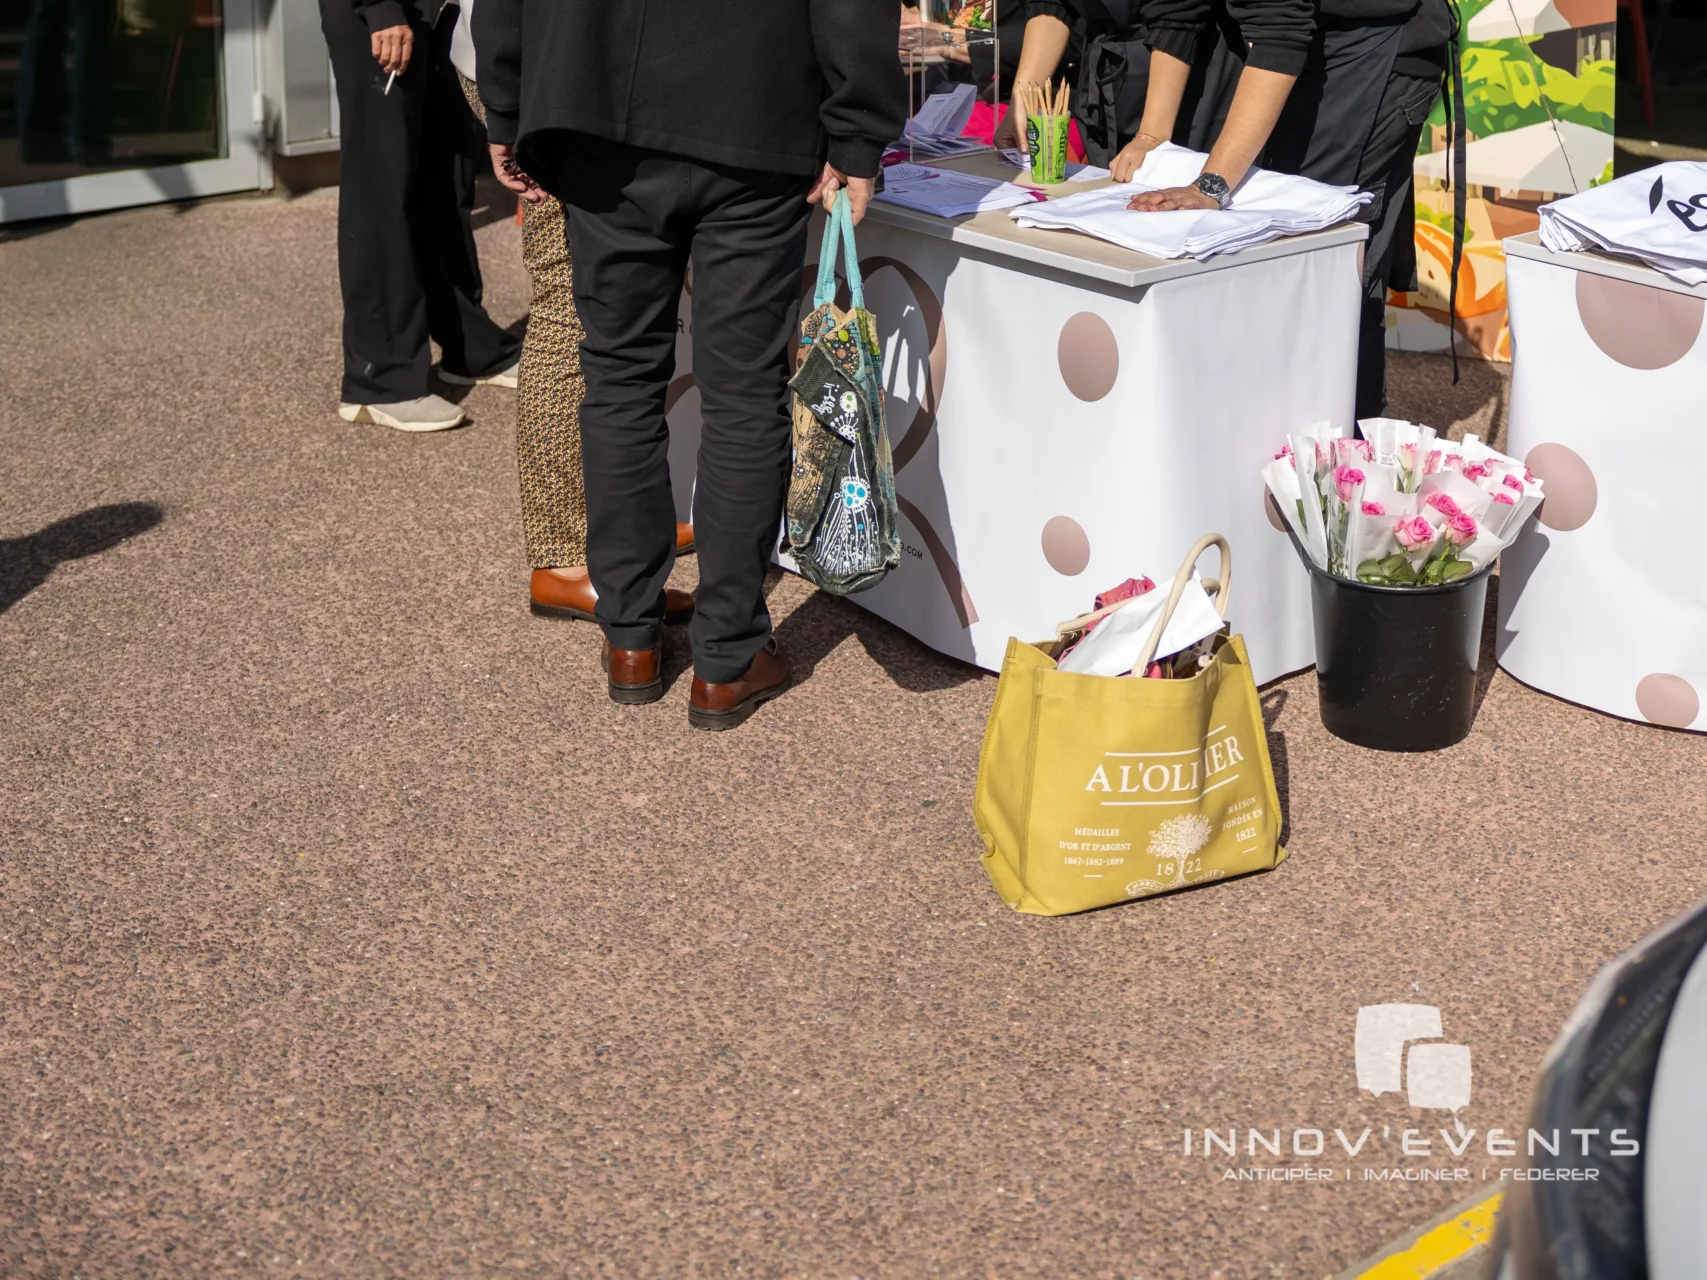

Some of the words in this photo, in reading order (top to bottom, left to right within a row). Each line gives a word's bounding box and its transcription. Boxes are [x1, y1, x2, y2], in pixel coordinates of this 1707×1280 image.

[1084, 763, 1113, 793] A
[1119, 735, 1244, 793] L'OLIIER
[1228, 796, 1256, 814] MAISON
[1222, 812, 1251, 831] FONDÉE
[1252, 807, 1264, 819] EN
[1074, 827, 1120, 837] MÉDAILLES
[1235, 827, 1257, 842] 1822
[1059, 841, 1078, 850] D'OR
[1080, 842, 1091, 851] ET
[1092, 842, 1132, 851] D'ARGENT
